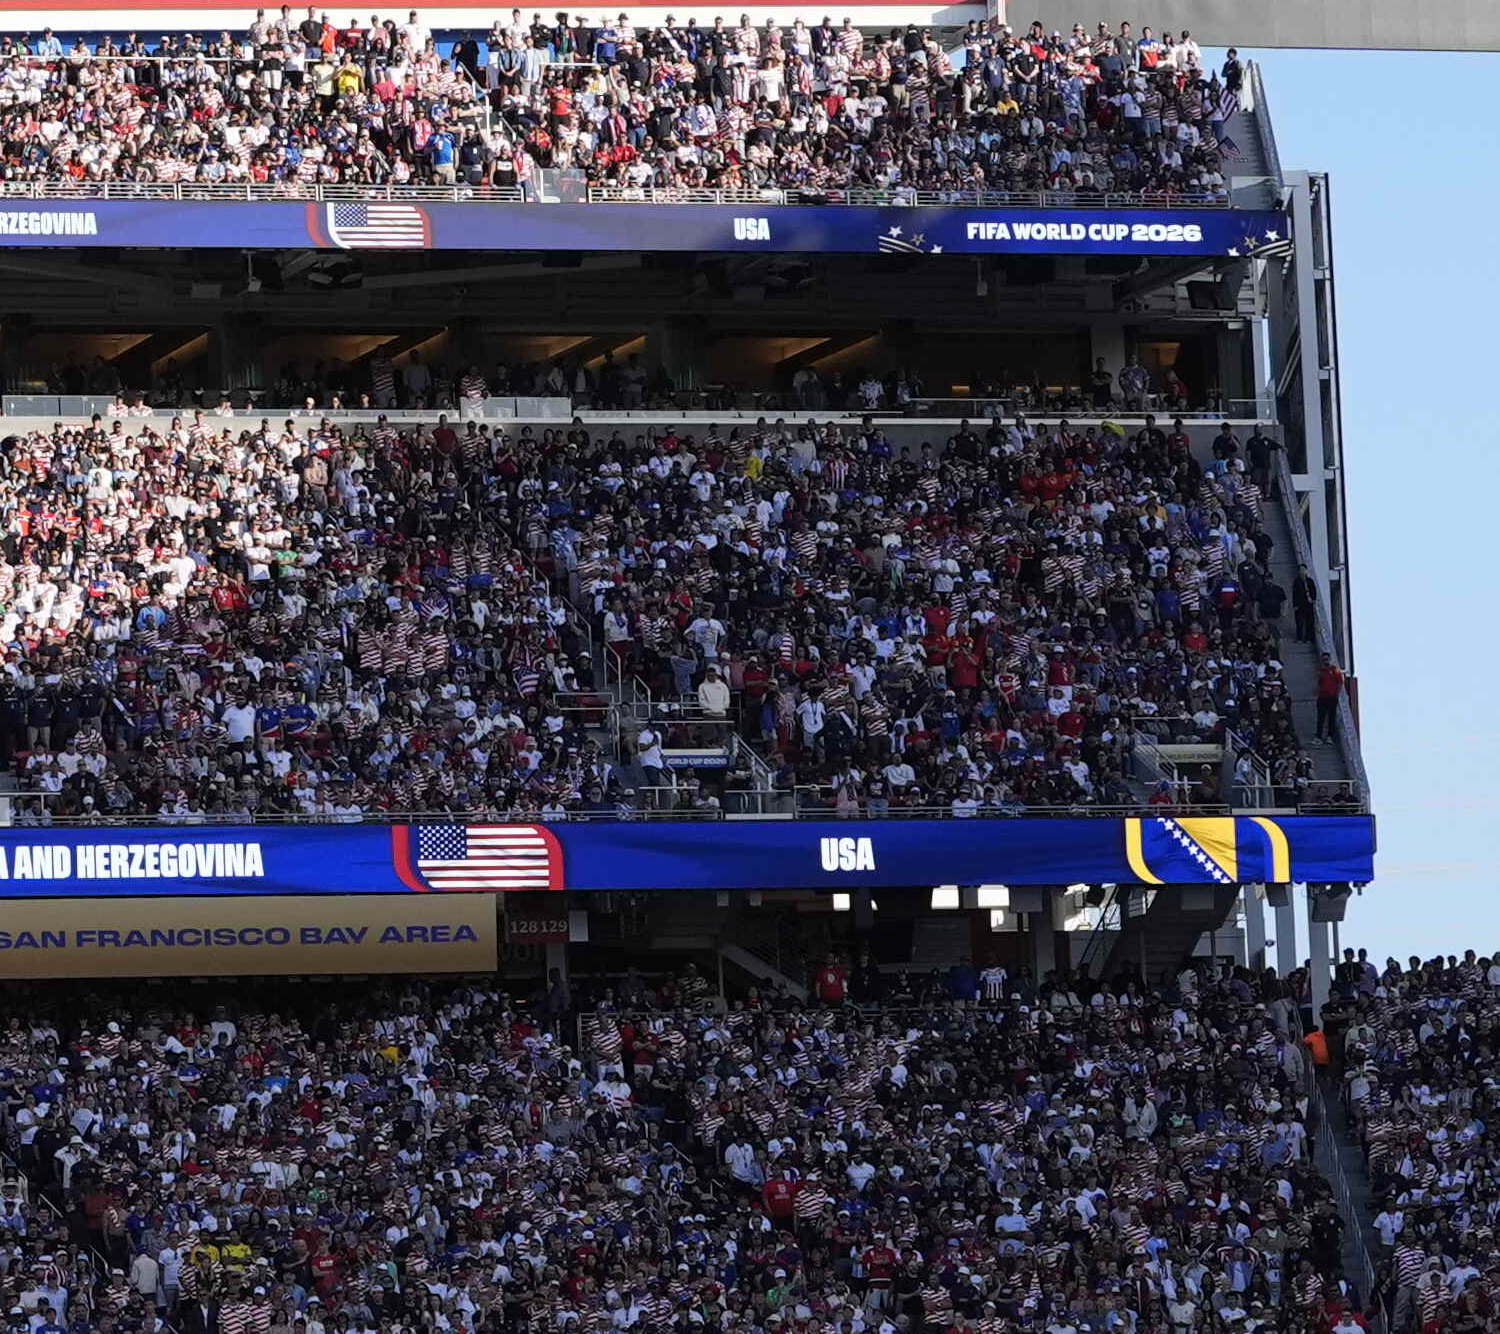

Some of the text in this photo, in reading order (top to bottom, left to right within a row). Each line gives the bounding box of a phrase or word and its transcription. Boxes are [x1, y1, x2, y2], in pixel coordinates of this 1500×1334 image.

[733, 218, 771, 242] USA
[967, 221, 1203, 243] FIFA WORLD CUP 2026
[14, 844, 71, 880] AND
[76, 842, 265, 879] HERZEGOVINA
[820, 836, 875, 873] USA
[75, 926, 291, 949] FRANCISCO
[300, 925, 370, 946] BAY
[379, 923, 479, 944] AREA
